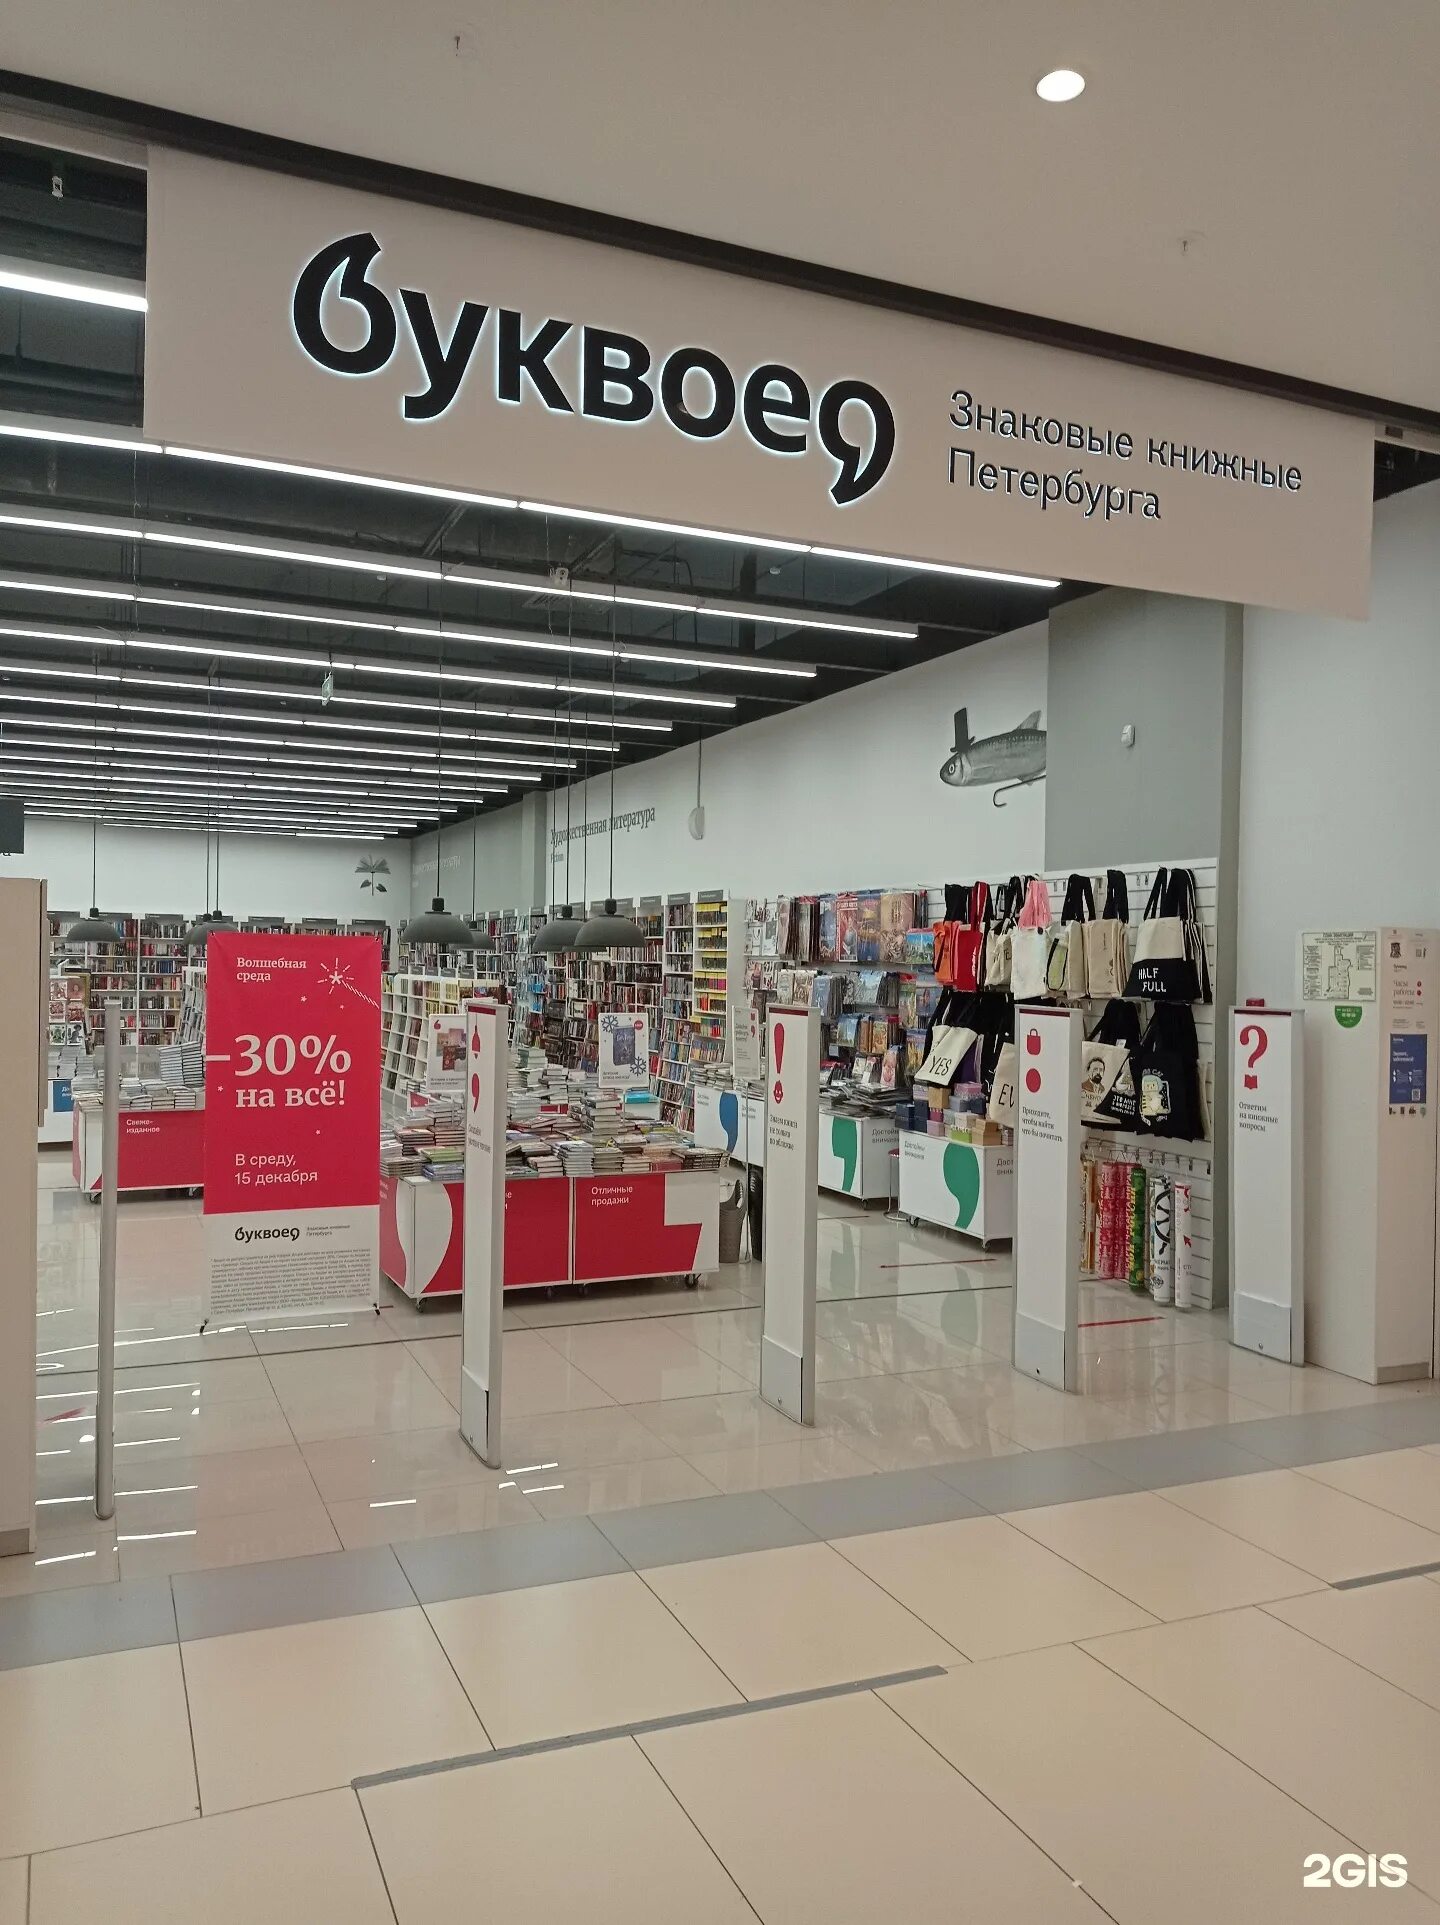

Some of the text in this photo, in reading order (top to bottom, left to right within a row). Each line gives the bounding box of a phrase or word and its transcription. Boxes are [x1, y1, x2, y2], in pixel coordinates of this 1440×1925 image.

[949, 390, 1302, 492] Знаковые книжные
[948, 446, 1162, 521] Петербурга
[608, 807, 656, 833] литература
[236, 957, 307, 969] Волшебная
[236, 971, 271, 981] среда
[1138, 967, 1159, 980] HALF
[1142, 981, 1167, 993] FULL
[928, 1055, 952, 1077] YES
[235, 1080, 346, 1108] на всё!
[1238, 1101, 1267, 1113] Ответим
[1239, 1112, 1247, 1120] на
[126, 1126, 160, 1134] изданное
[1238, 1121, 1266, 1132] вопросы
[235, 1154, 297, 1167] В среду,
[234, 1170, 318, 1186] 15 декабря
[591, 1185, 634, 1195] Отличные
[591, 1197, 630, 1206] продажи
